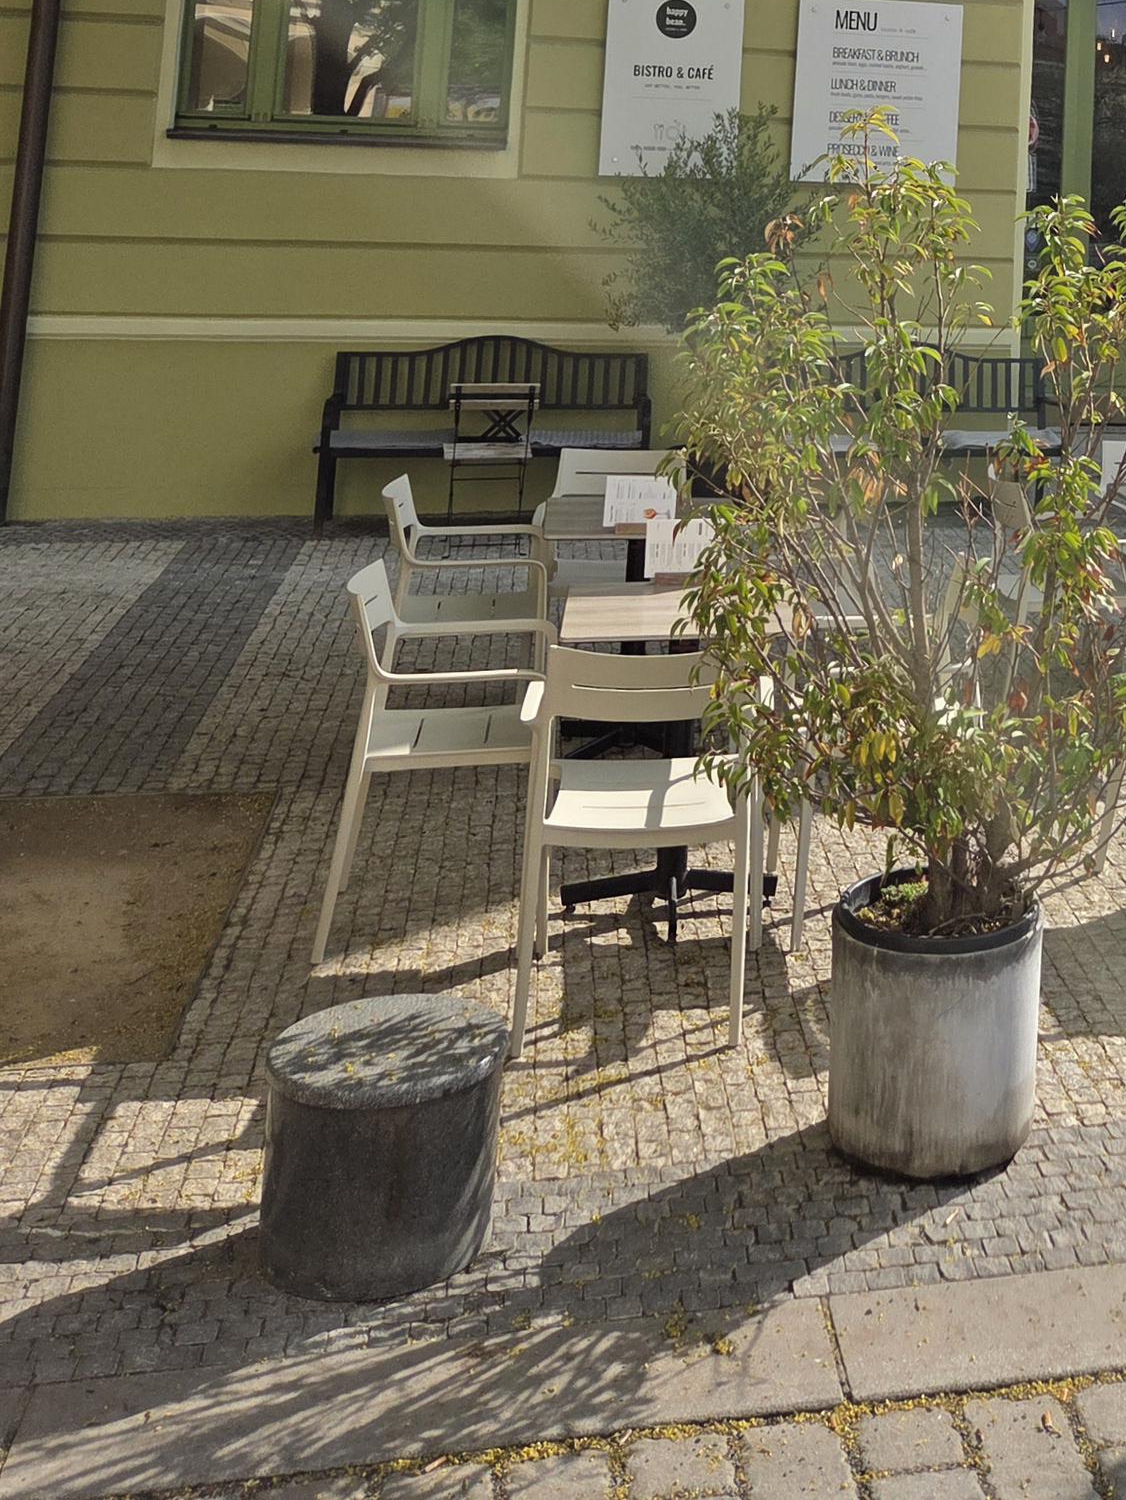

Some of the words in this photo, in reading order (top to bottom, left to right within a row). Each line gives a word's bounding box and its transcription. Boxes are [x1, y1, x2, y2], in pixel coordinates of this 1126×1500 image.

[665, 6, 689, 18] happy
[835, 9, 878, 32] MENU
[832, 46, 876, 61] BREAKFAST
[876, 49, 884, 61] &
[885, 50, 920, 63] BRUNCH
[633, 64, 673, 78] BISTRO
[676, 66, 685, 79] &
[687, 64, 714, 81] CAFÉ
[830, 78, 859, 91] LUNCH
[859, 80, 867, 92] &
[867, 80, 897, 93] DINNER
[879, 145, 900, 158] WINE
